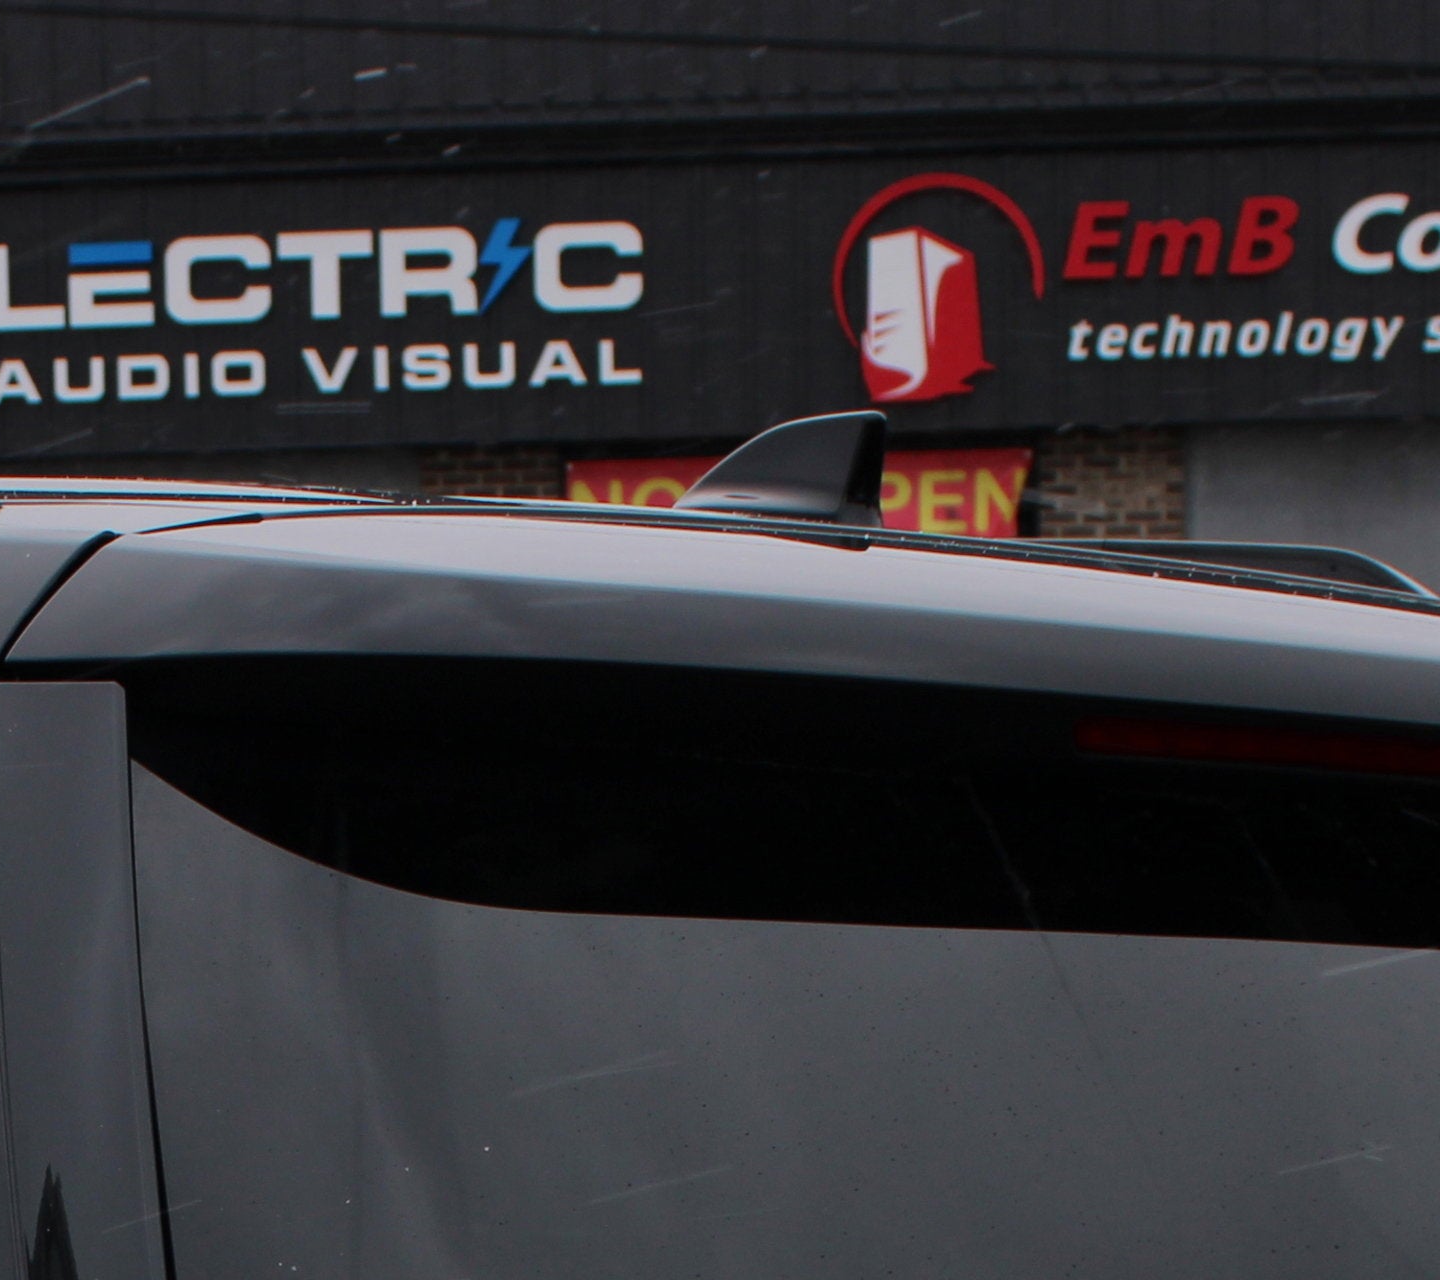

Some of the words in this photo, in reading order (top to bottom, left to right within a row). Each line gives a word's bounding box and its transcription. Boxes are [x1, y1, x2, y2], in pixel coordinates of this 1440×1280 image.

[1062, 195, 1301, 280] EmB
[301, 338, 643, 394] VISUAL
[1067, 310, 1405, 362] technology
[879, 467, 1026, 532] PEN
